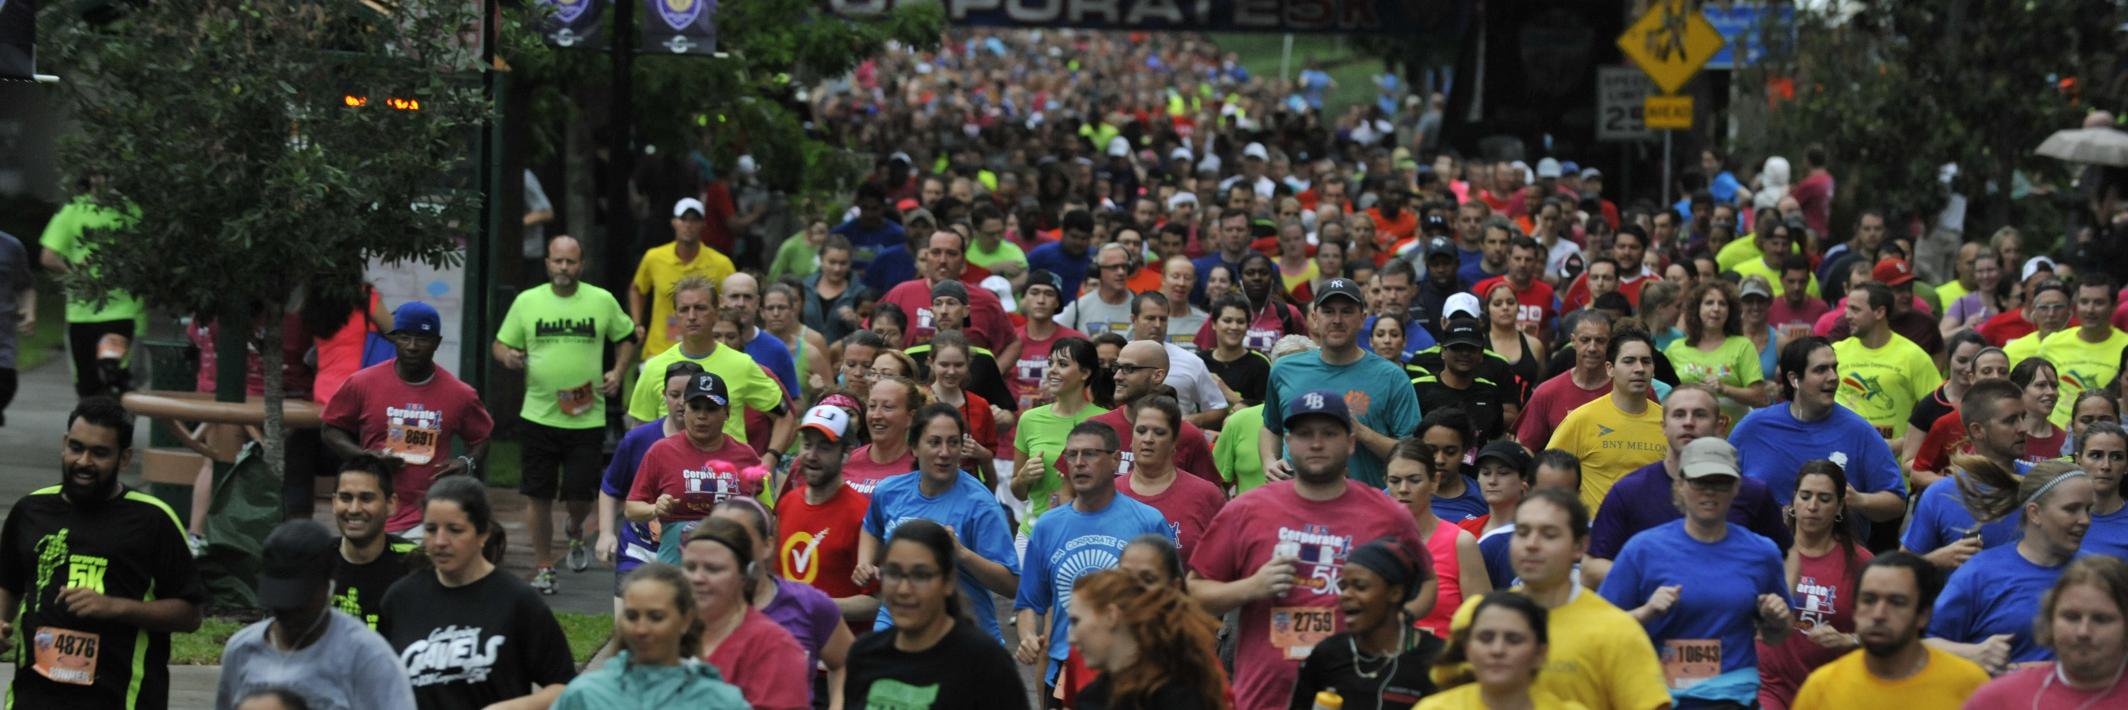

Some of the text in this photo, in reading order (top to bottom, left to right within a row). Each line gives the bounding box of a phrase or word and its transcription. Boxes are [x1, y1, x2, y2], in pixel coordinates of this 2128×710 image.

[1303, 392, 1325, 410] TB
[386, 406, 436, 420] Corporate
[405, 429, 434, 446] 8691
[1602, 440, 1668, 454] BNY MELLON
[1065, 534, 1118, 551] CORPORATE
[1278, 527, 1344, 546] Corporate
[67, 563, 107, 594] 5K
[1294, 611, 1333, 632] 2759
[54, 633, 96, 658] 4876
[1678, 645, 1720, 663] 10643
[400, 634, 507, 676] GAVELS
